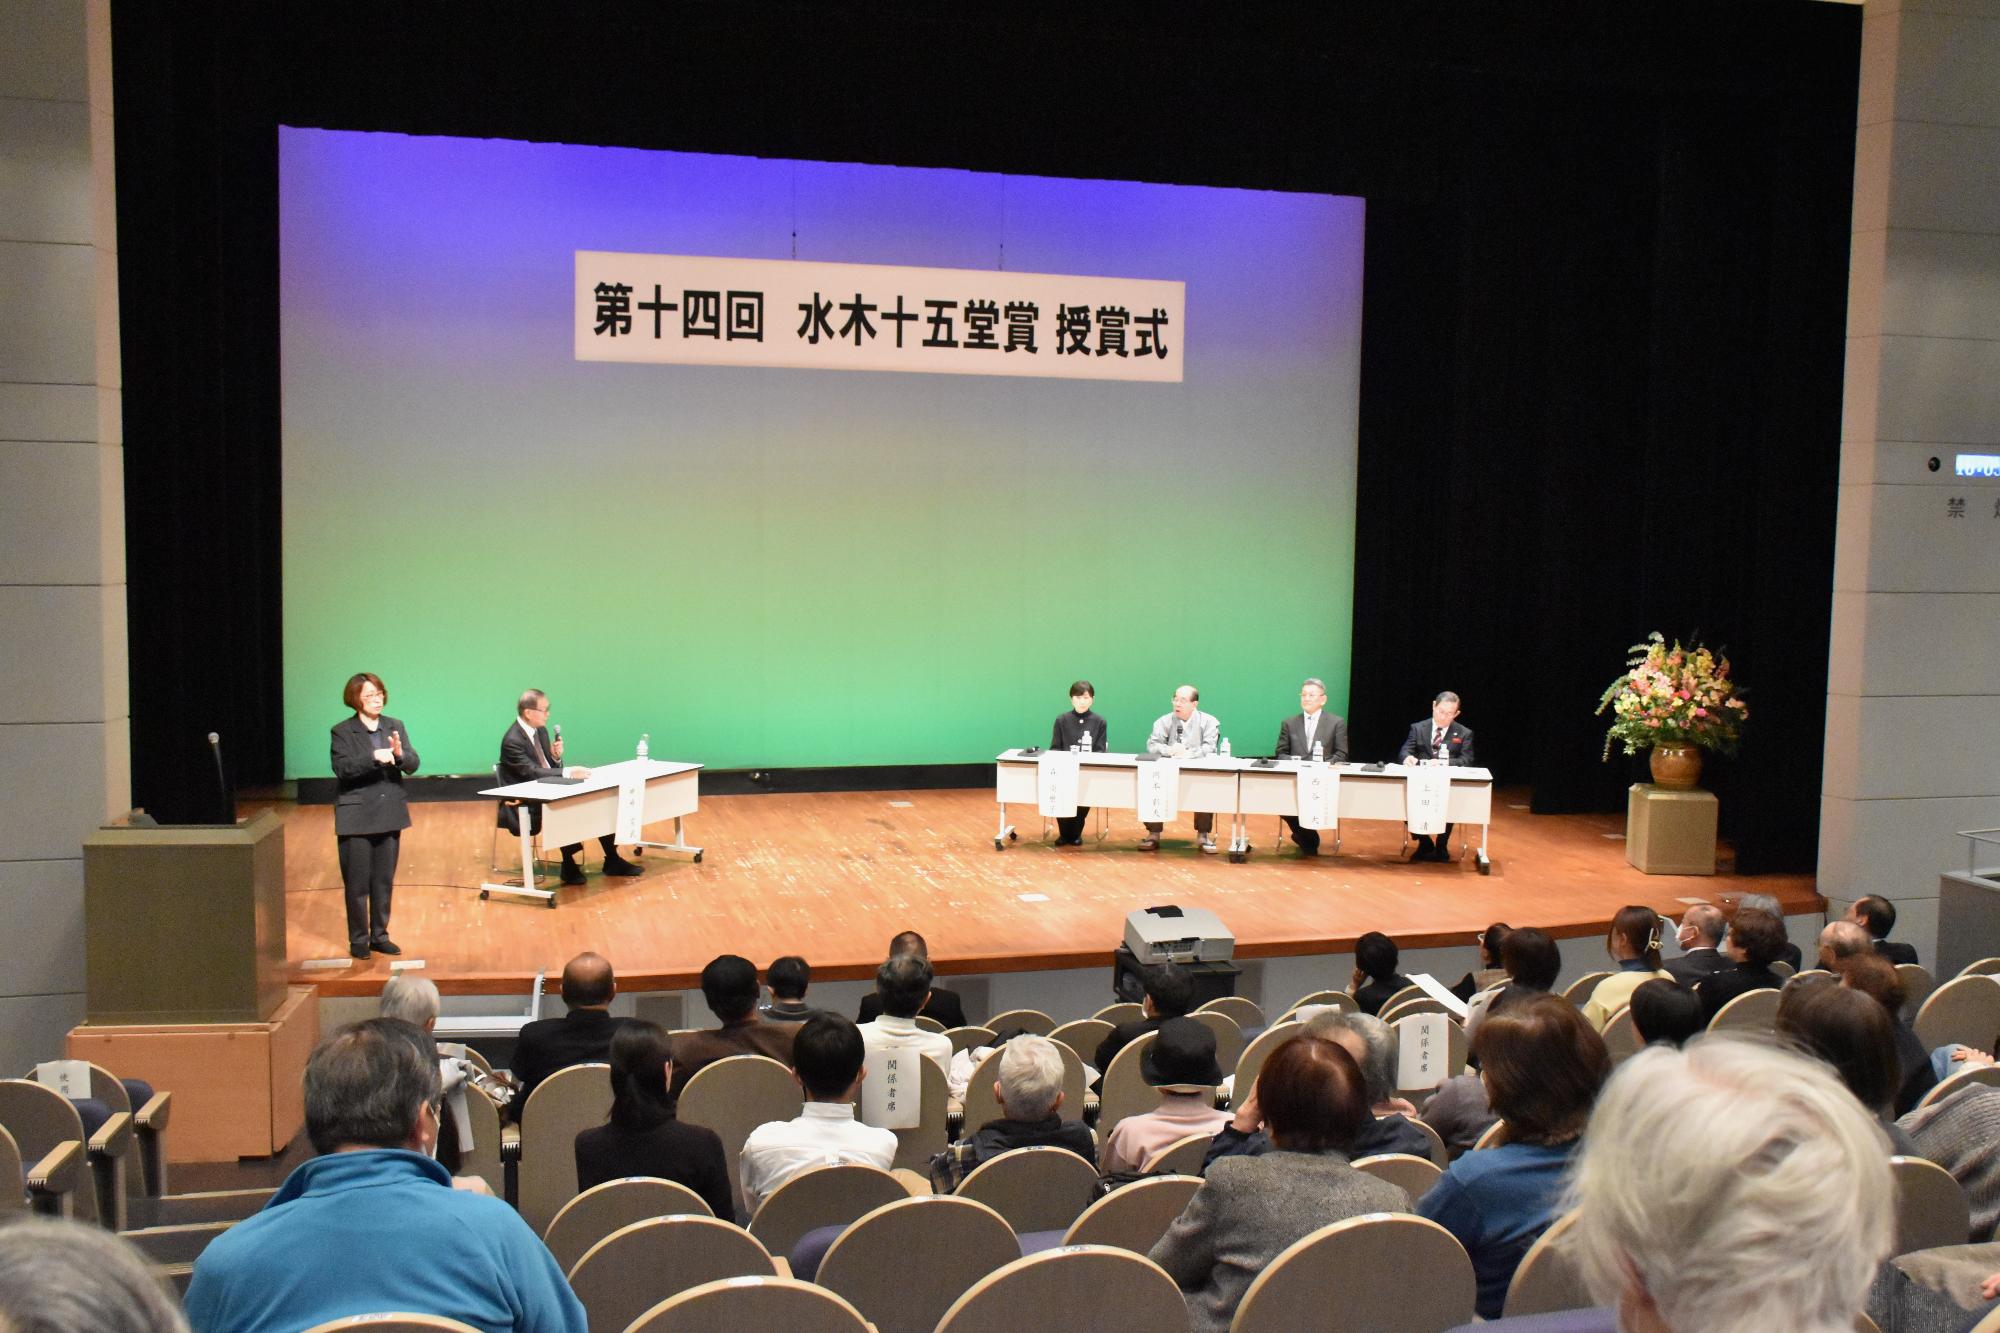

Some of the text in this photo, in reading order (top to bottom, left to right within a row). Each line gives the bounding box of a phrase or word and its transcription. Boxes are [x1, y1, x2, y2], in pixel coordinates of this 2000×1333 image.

[594, 282, 1168, 359] 第十四回 水木十五堂賞 授賞式
[886, 1059, 898, 1112] 関係者席
